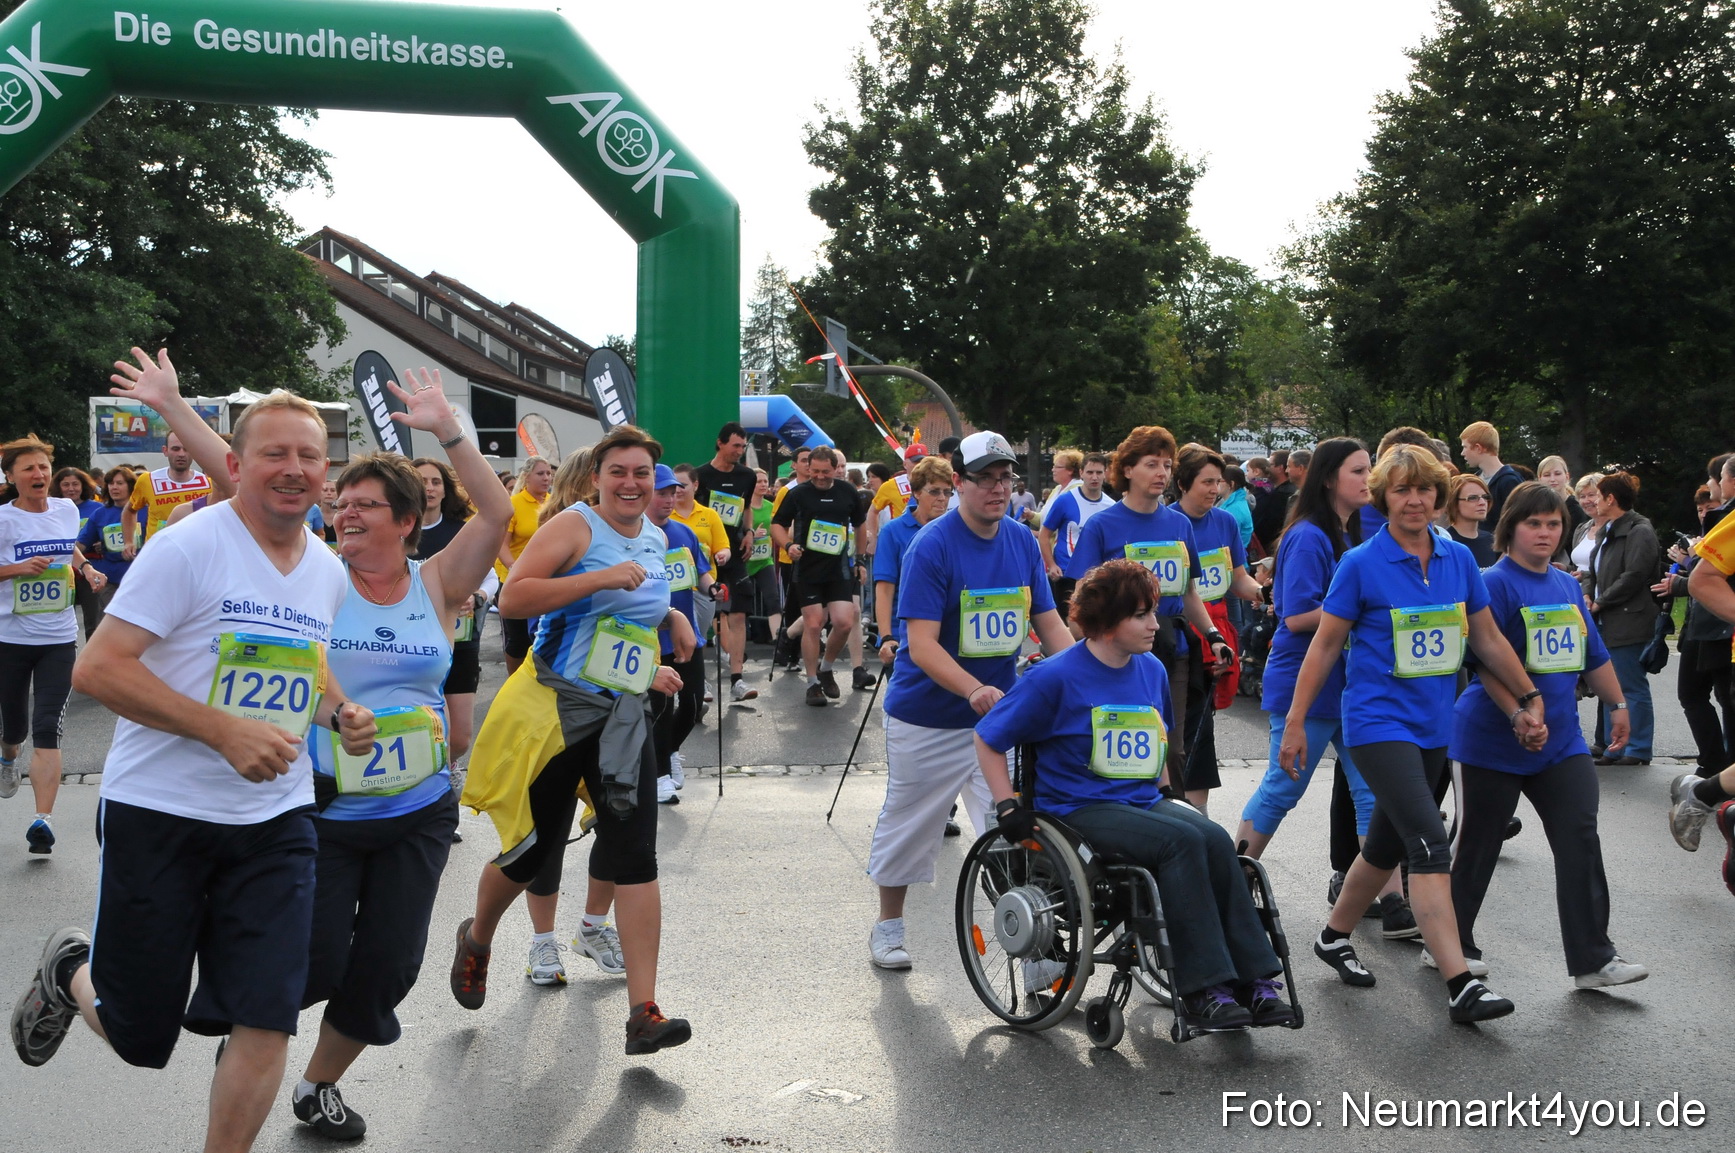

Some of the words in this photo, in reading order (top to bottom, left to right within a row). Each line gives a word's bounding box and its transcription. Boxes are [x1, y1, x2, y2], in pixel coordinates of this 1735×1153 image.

[114, 11, 171, 46] Die
[193, 18, 514, 69] Gesundheitskasse.
[0, 20, 91, 135] OK
[545, 91, 700, 219] AOK
[100, 416, 147, 432] TLA
[155, 496, 181, 506] MAX
[711, 501, 735, 517] 514
[811, 530, 839, 547] 515
[1140, 559, 1178, 582] 40
[19, 580, 61, 603] 896
[221, 600, 269, 616] Seßler
[271, 605, 280, 619] &
[969, 610, 1018, 640] 106
[330, 638, 439, 657] SCHABMÜLLER
[1411, 628, 1445, 659] 83
[1533, 626, 1575, 656] 164
[370, 657, 399, 666] TEAM
[611, 640, 642, 675] 16
[607, 669, 619, 678] Ute
[220, 669, 310, 714] 1220
[1102, 729, 1151, 760] 168
[362, 736, 407, 778] 21
[360, 775, 402, 788] Christine
